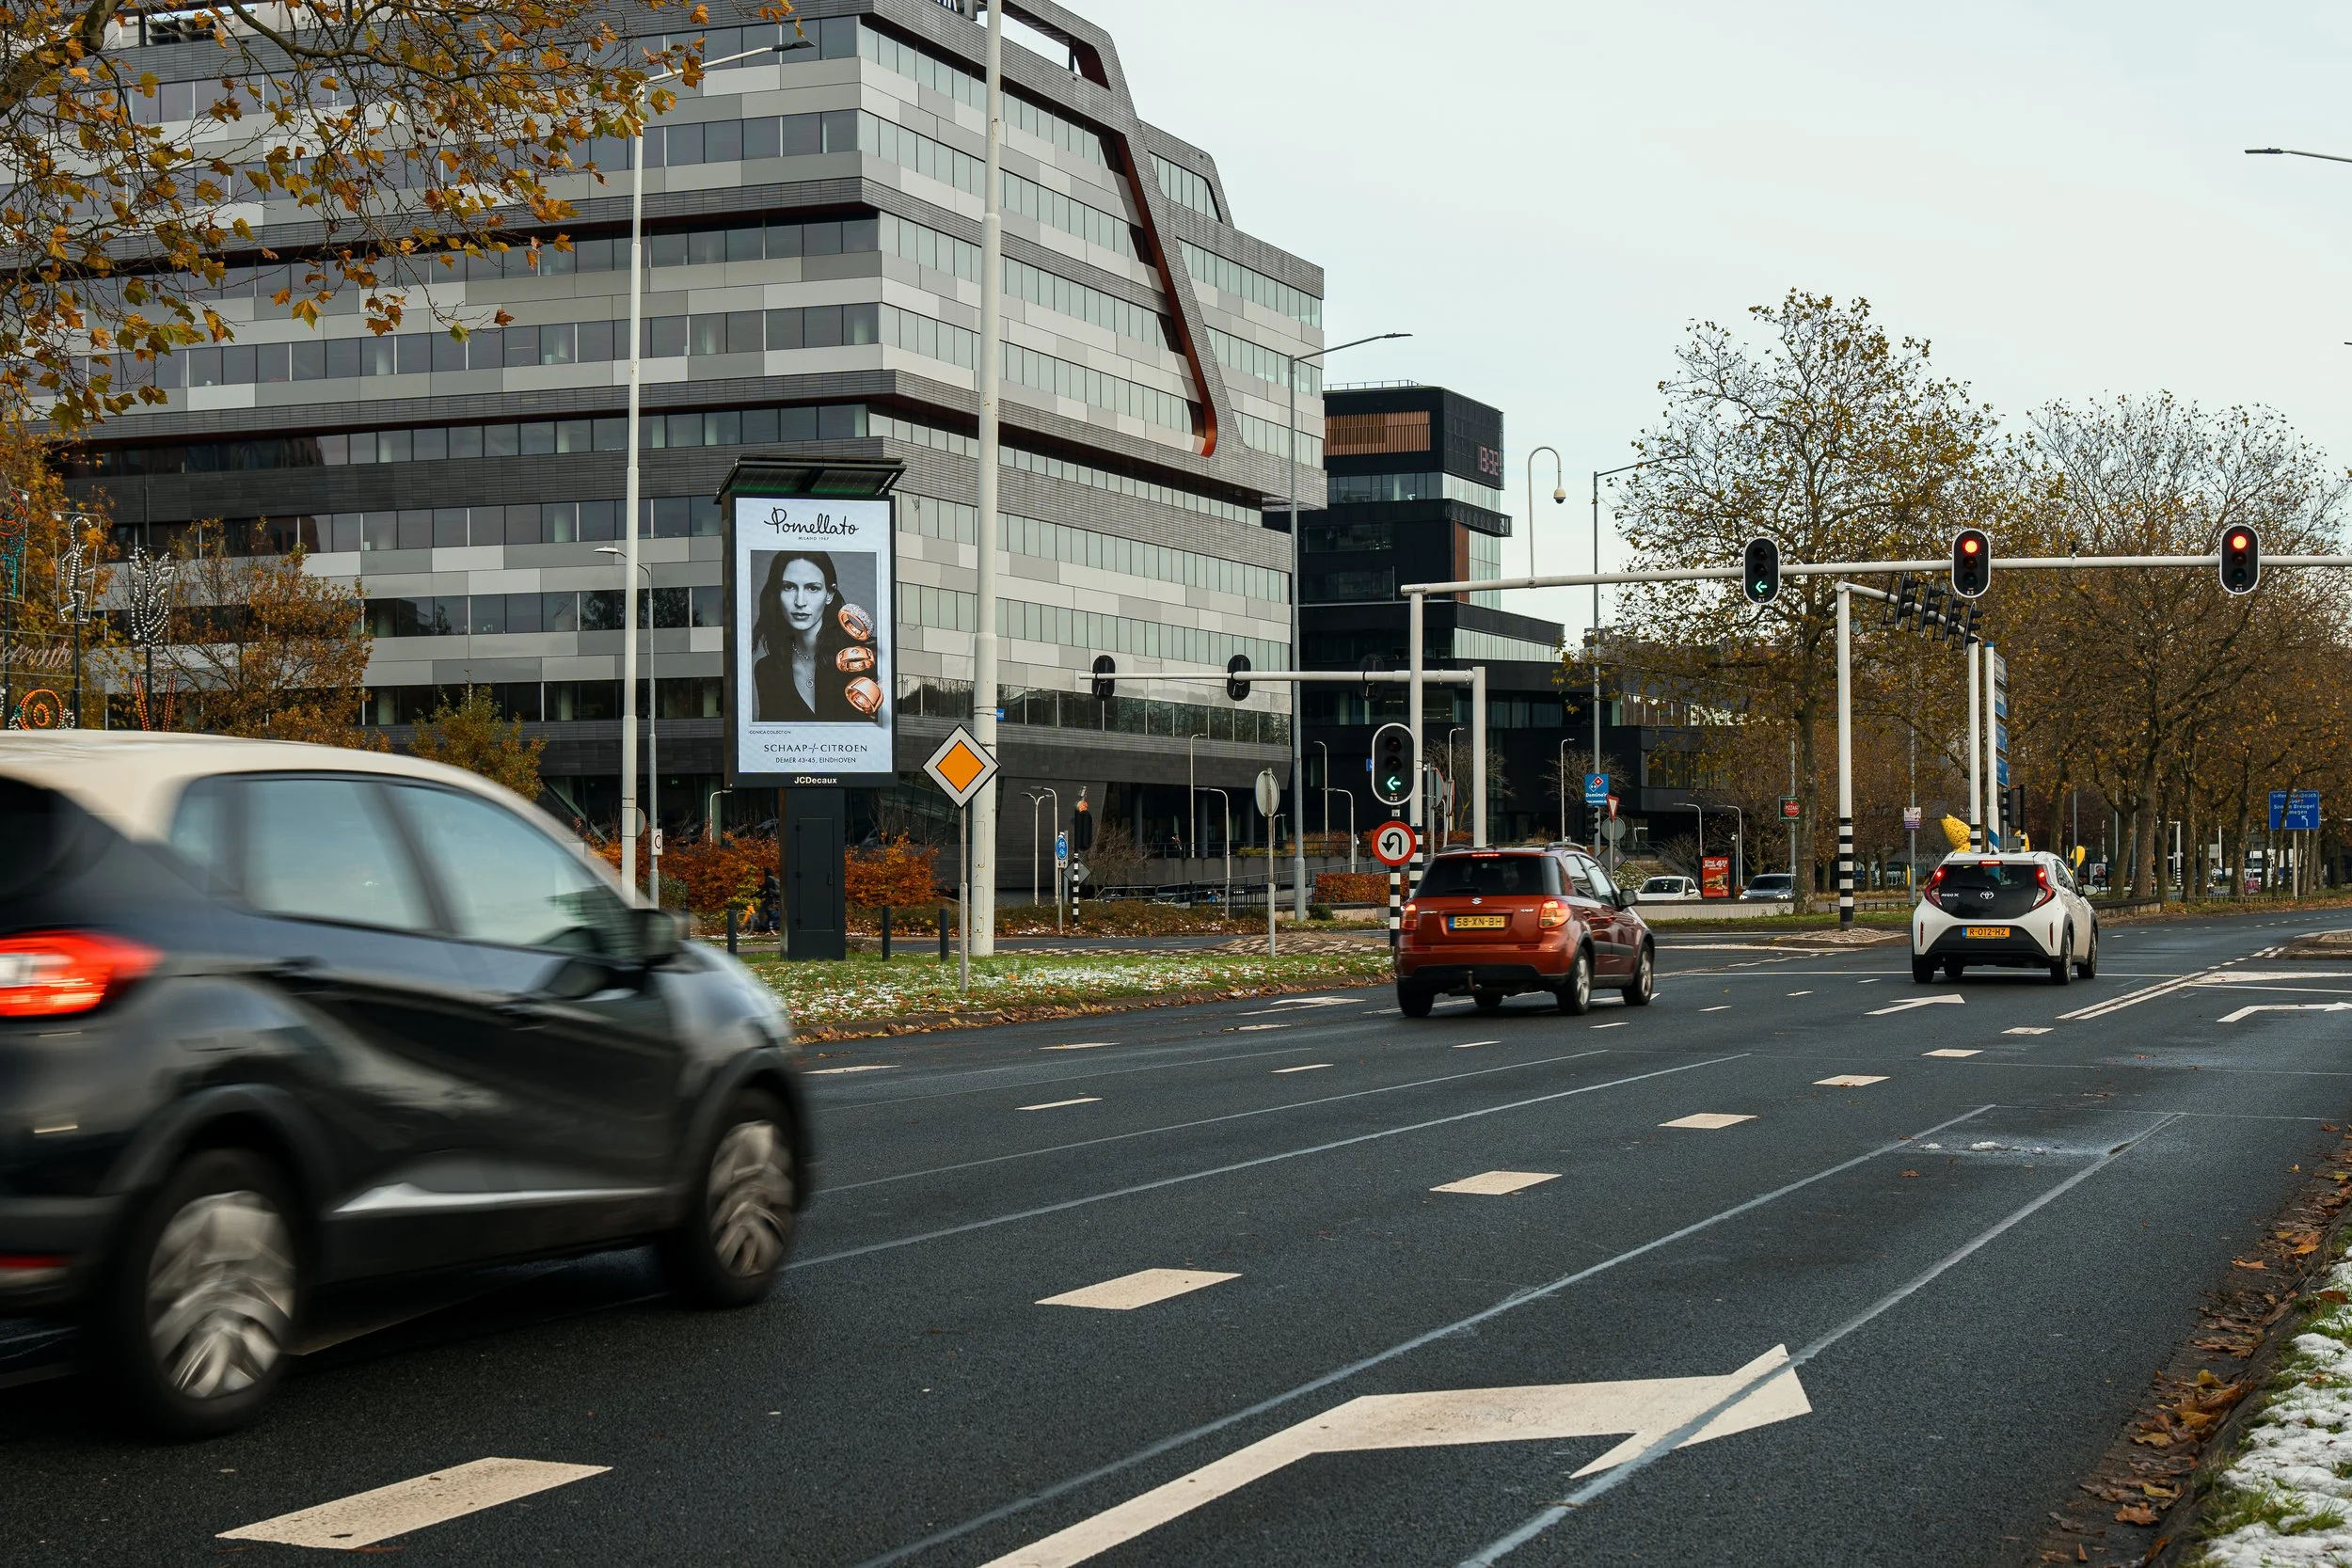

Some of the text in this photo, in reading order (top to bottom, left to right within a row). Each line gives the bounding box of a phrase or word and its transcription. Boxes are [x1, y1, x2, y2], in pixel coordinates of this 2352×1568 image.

[763, 507, 859, 535] Pomellato
[794, 776, 837, 784] JCDecaux
[1455, 917, 1502, 927] 58-XN-BH
[1969, 927, 2006, 936] R-012-HZ
